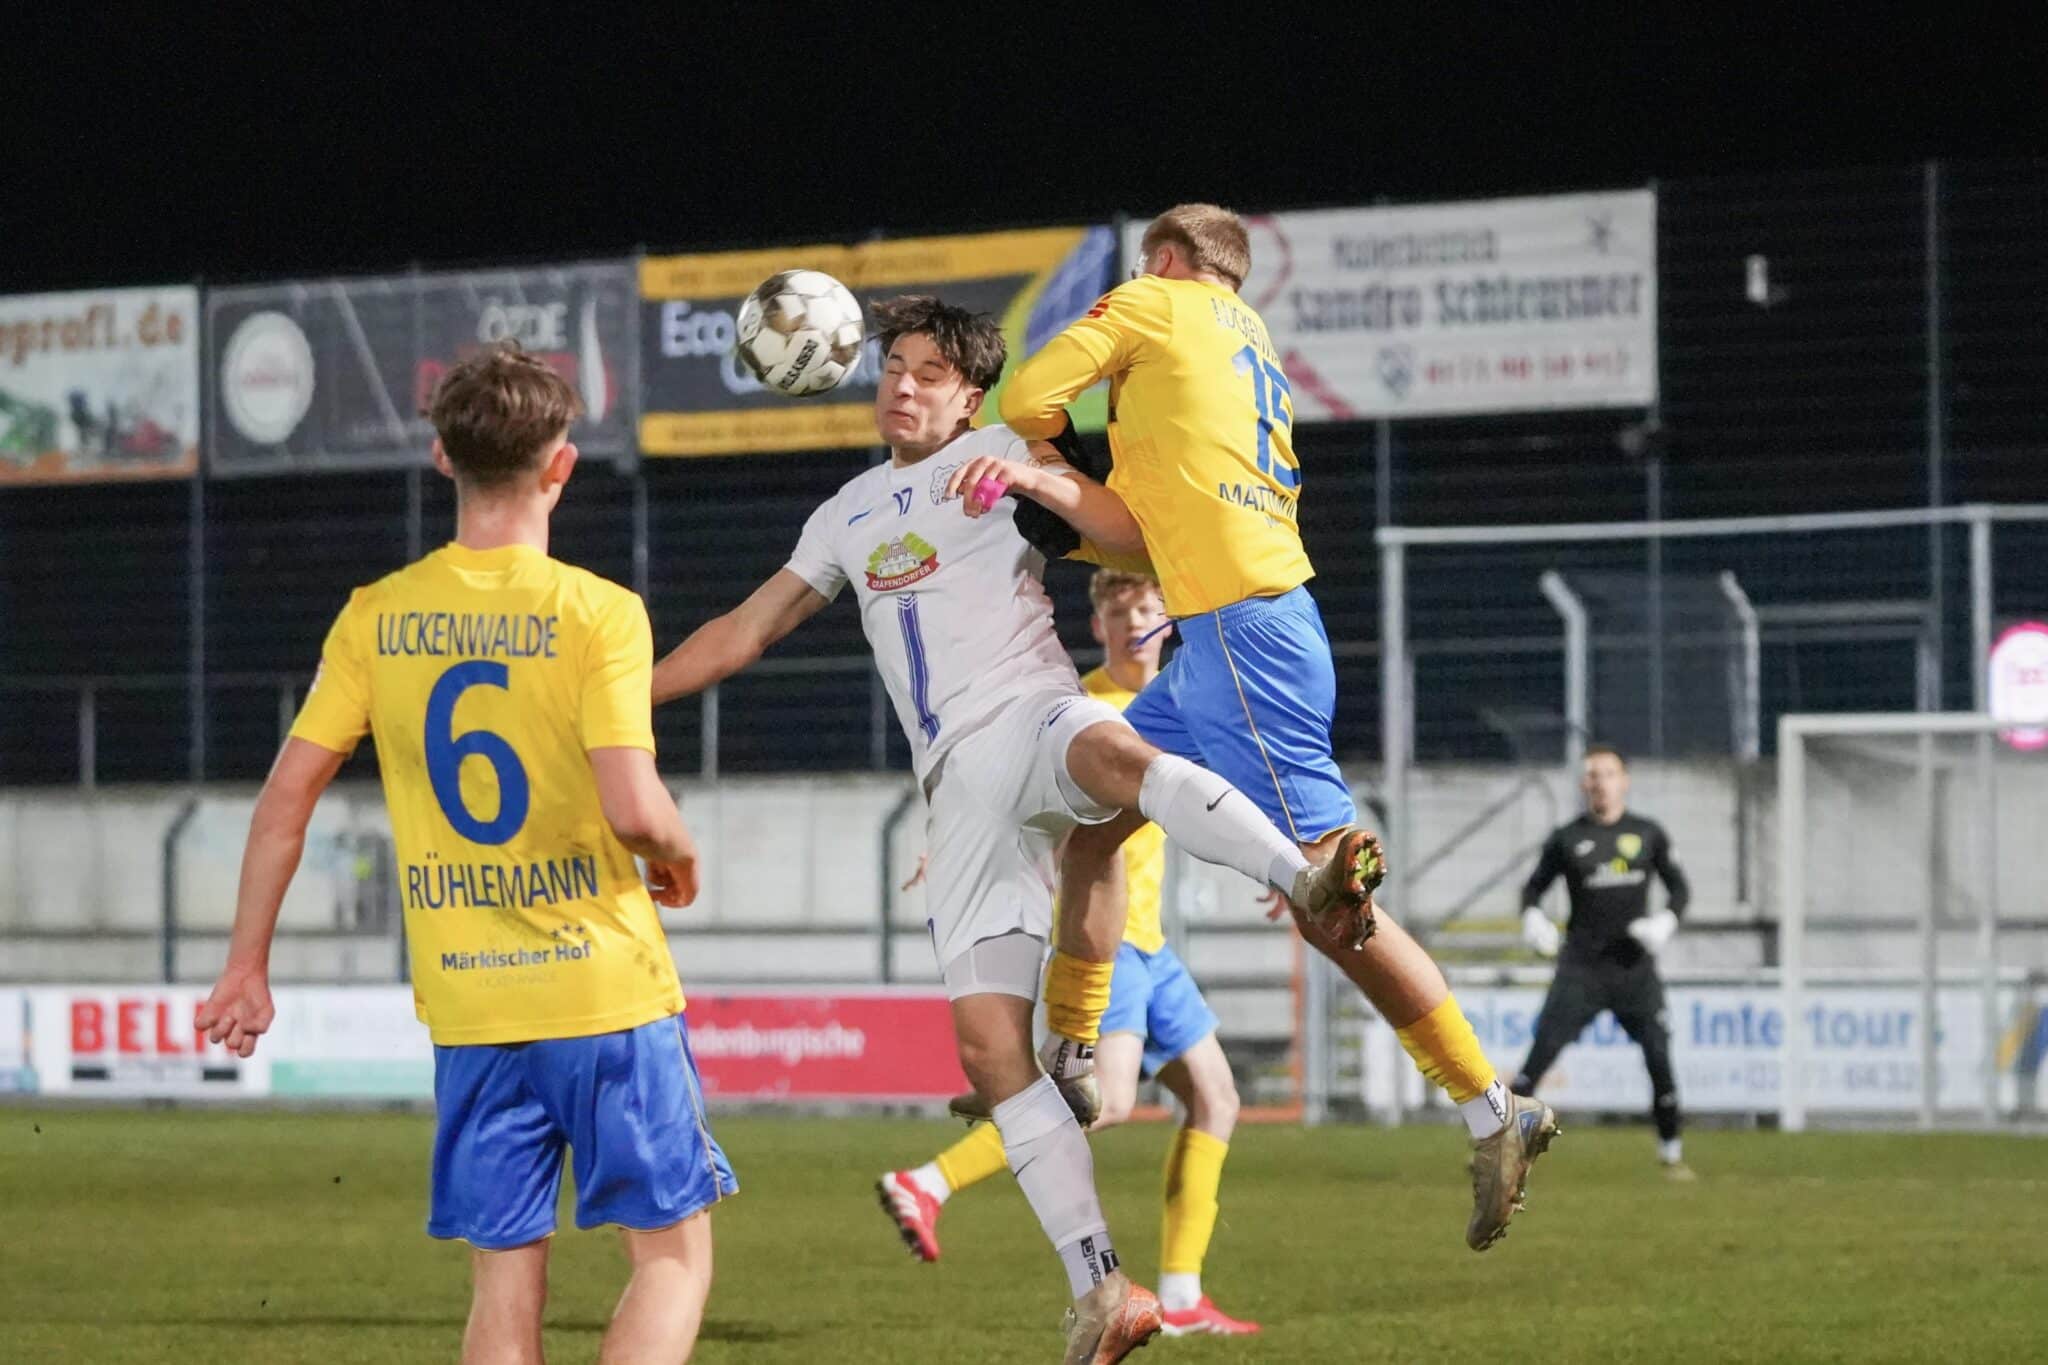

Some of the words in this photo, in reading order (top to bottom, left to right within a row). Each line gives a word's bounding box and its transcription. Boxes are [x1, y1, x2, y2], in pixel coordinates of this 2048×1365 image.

[1231, 344, 1302, 489] 15
[893, 487, 913, 516] 17
[378, 612, 559, 660] LUCKENWALDE
[424, 659, 530, 846] 6
[408, 852, 600, 909] RÜHLEMANN
[441, 947, 551, 971] Märkischer
[555, 940, 591, 961] Hof
